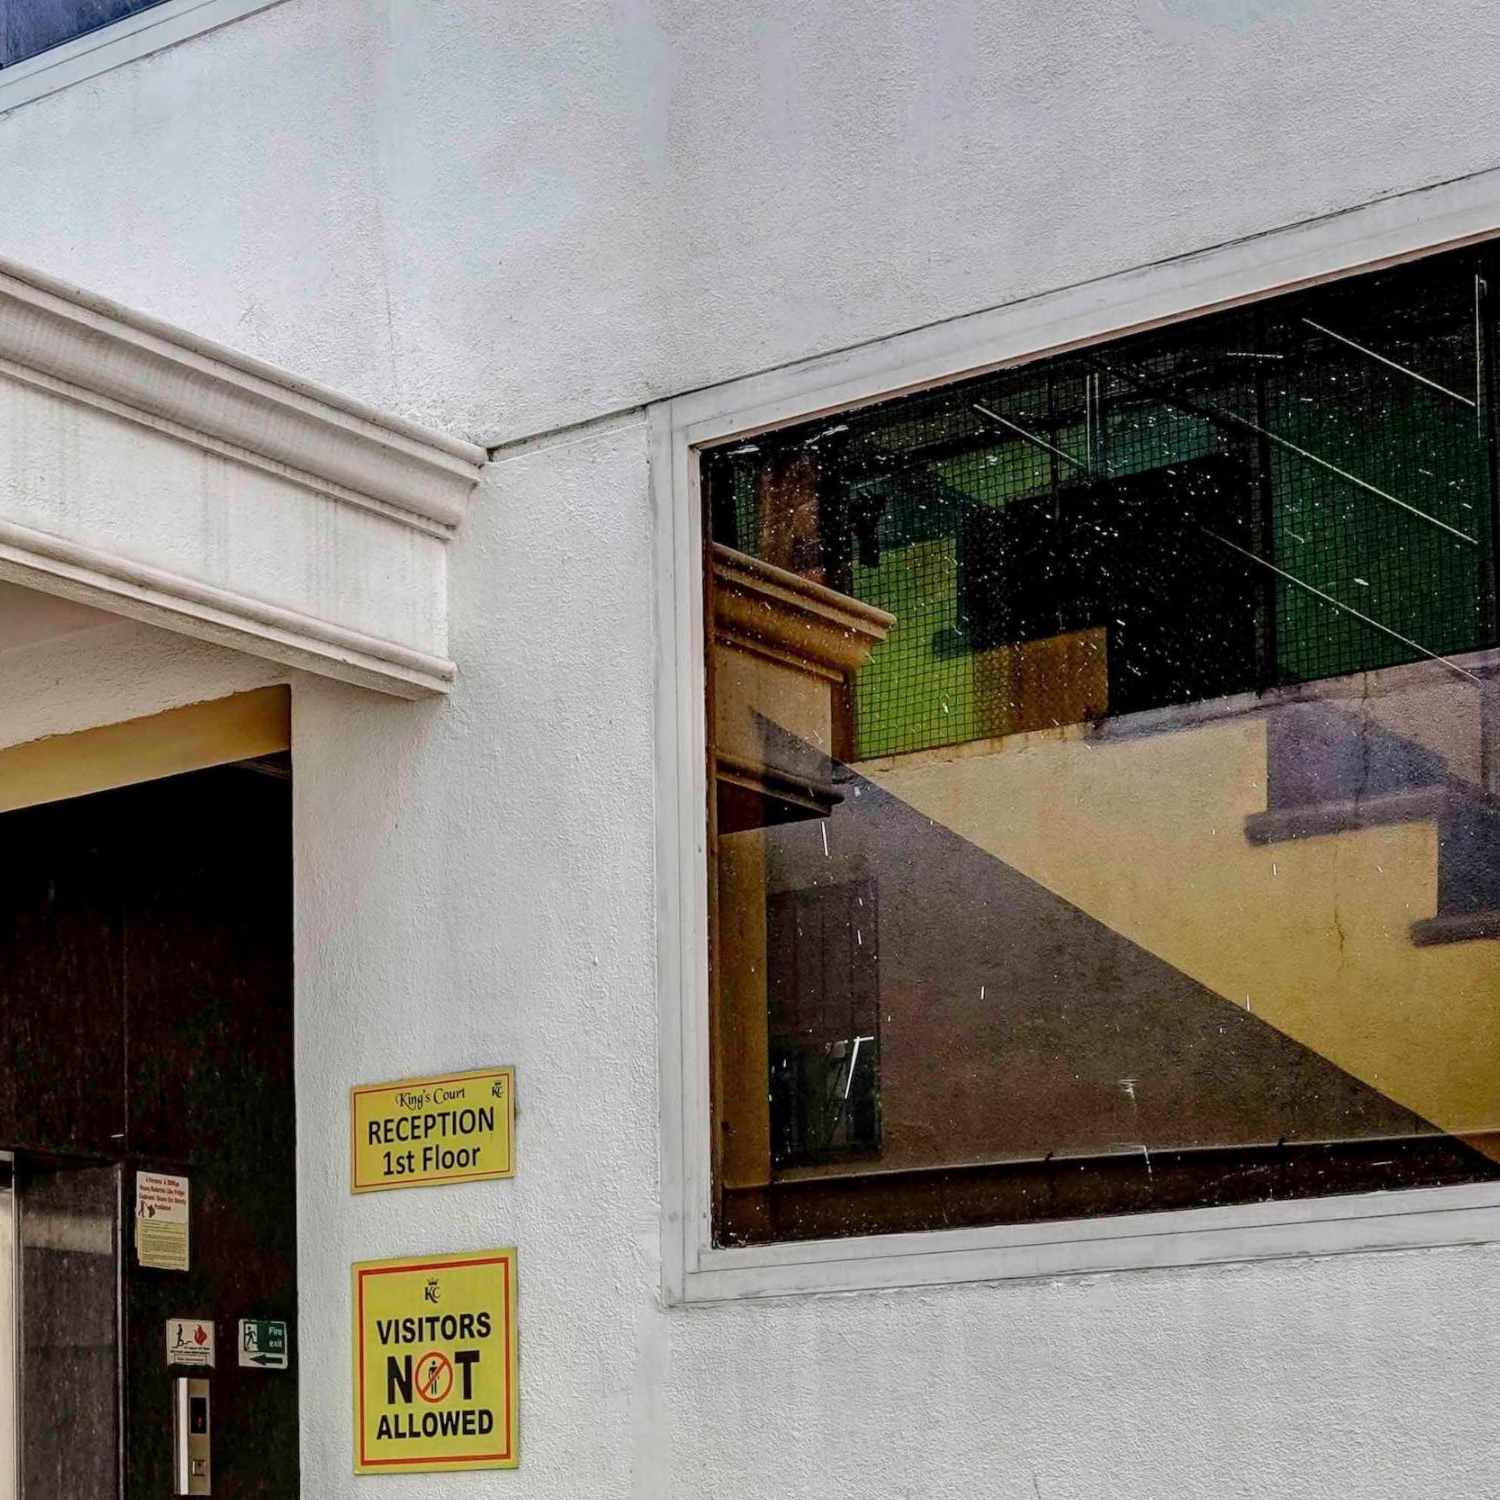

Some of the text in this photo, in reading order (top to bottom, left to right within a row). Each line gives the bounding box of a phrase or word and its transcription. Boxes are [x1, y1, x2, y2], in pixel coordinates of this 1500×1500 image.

[395, 1087, 466, 1111] King's Court
[368, 1106, 494, 1146] RECEPTION
[383, 1144, 481, 1176] 1st Floor
[424, 1286, 441, 1304] KC
[376, 1312, 491, 1345] VISITORS
[387, 1350, 480, 1404] NOT
[376, 1409, 494, 1440] ALLOWED
